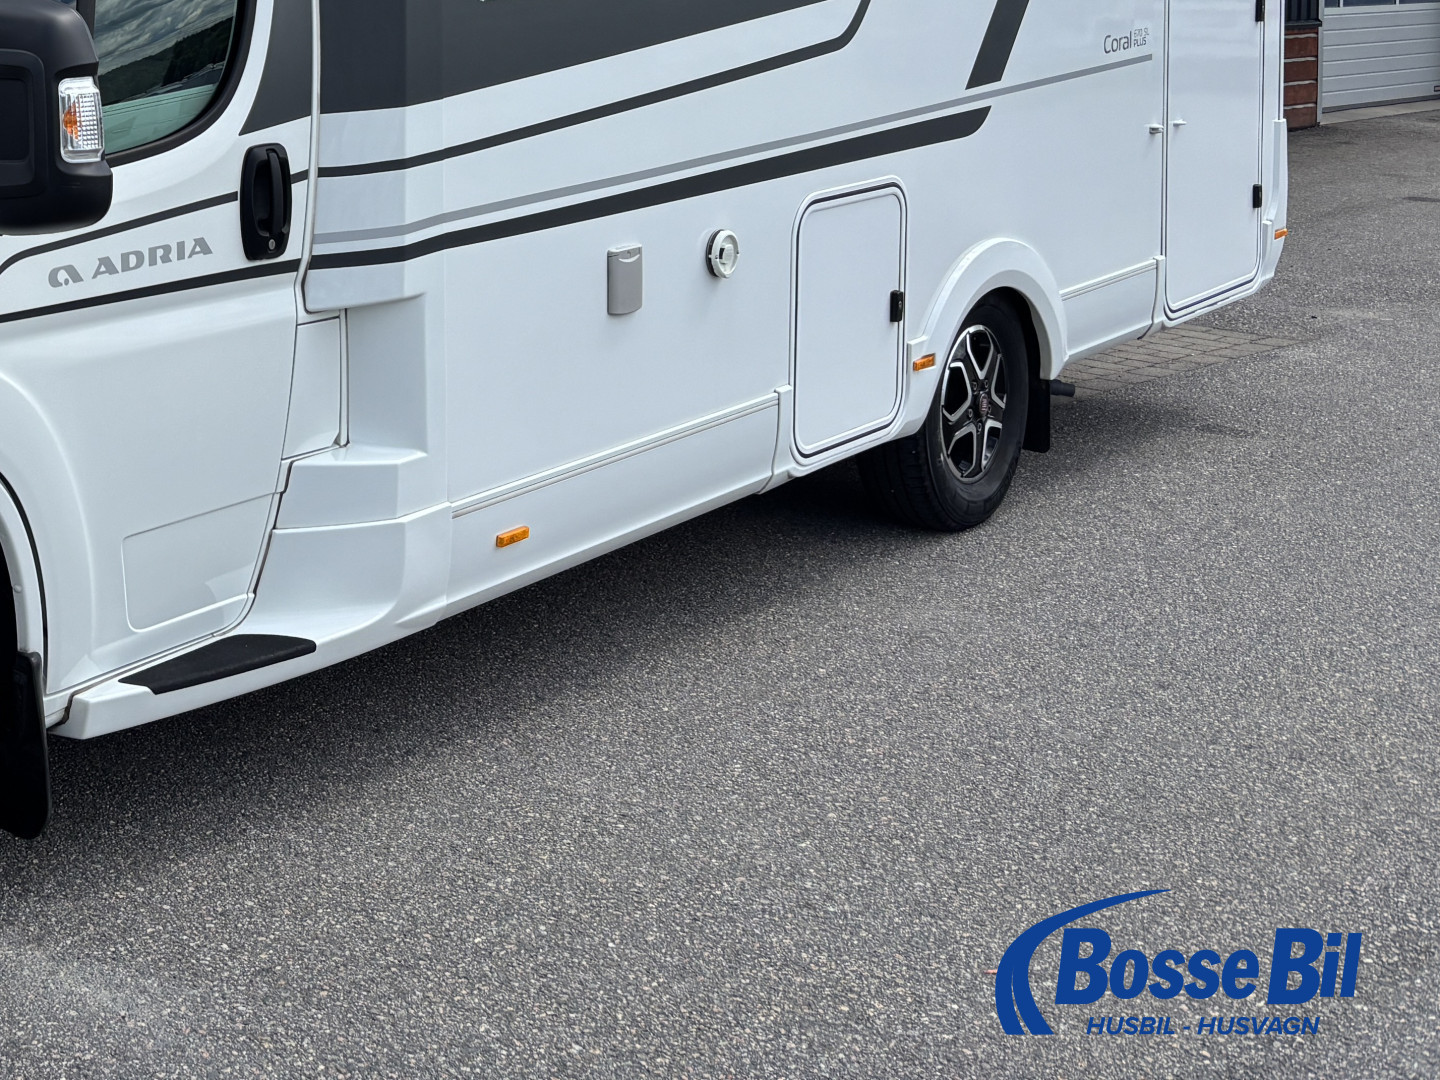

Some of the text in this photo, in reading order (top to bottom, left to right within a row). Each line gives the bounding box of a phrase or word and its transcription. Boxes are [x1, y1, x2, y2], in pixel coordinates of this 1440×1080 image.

[1103, 30, 1147, 54] Coral PLUS
[92, 237, 213, 279] ADRIA
